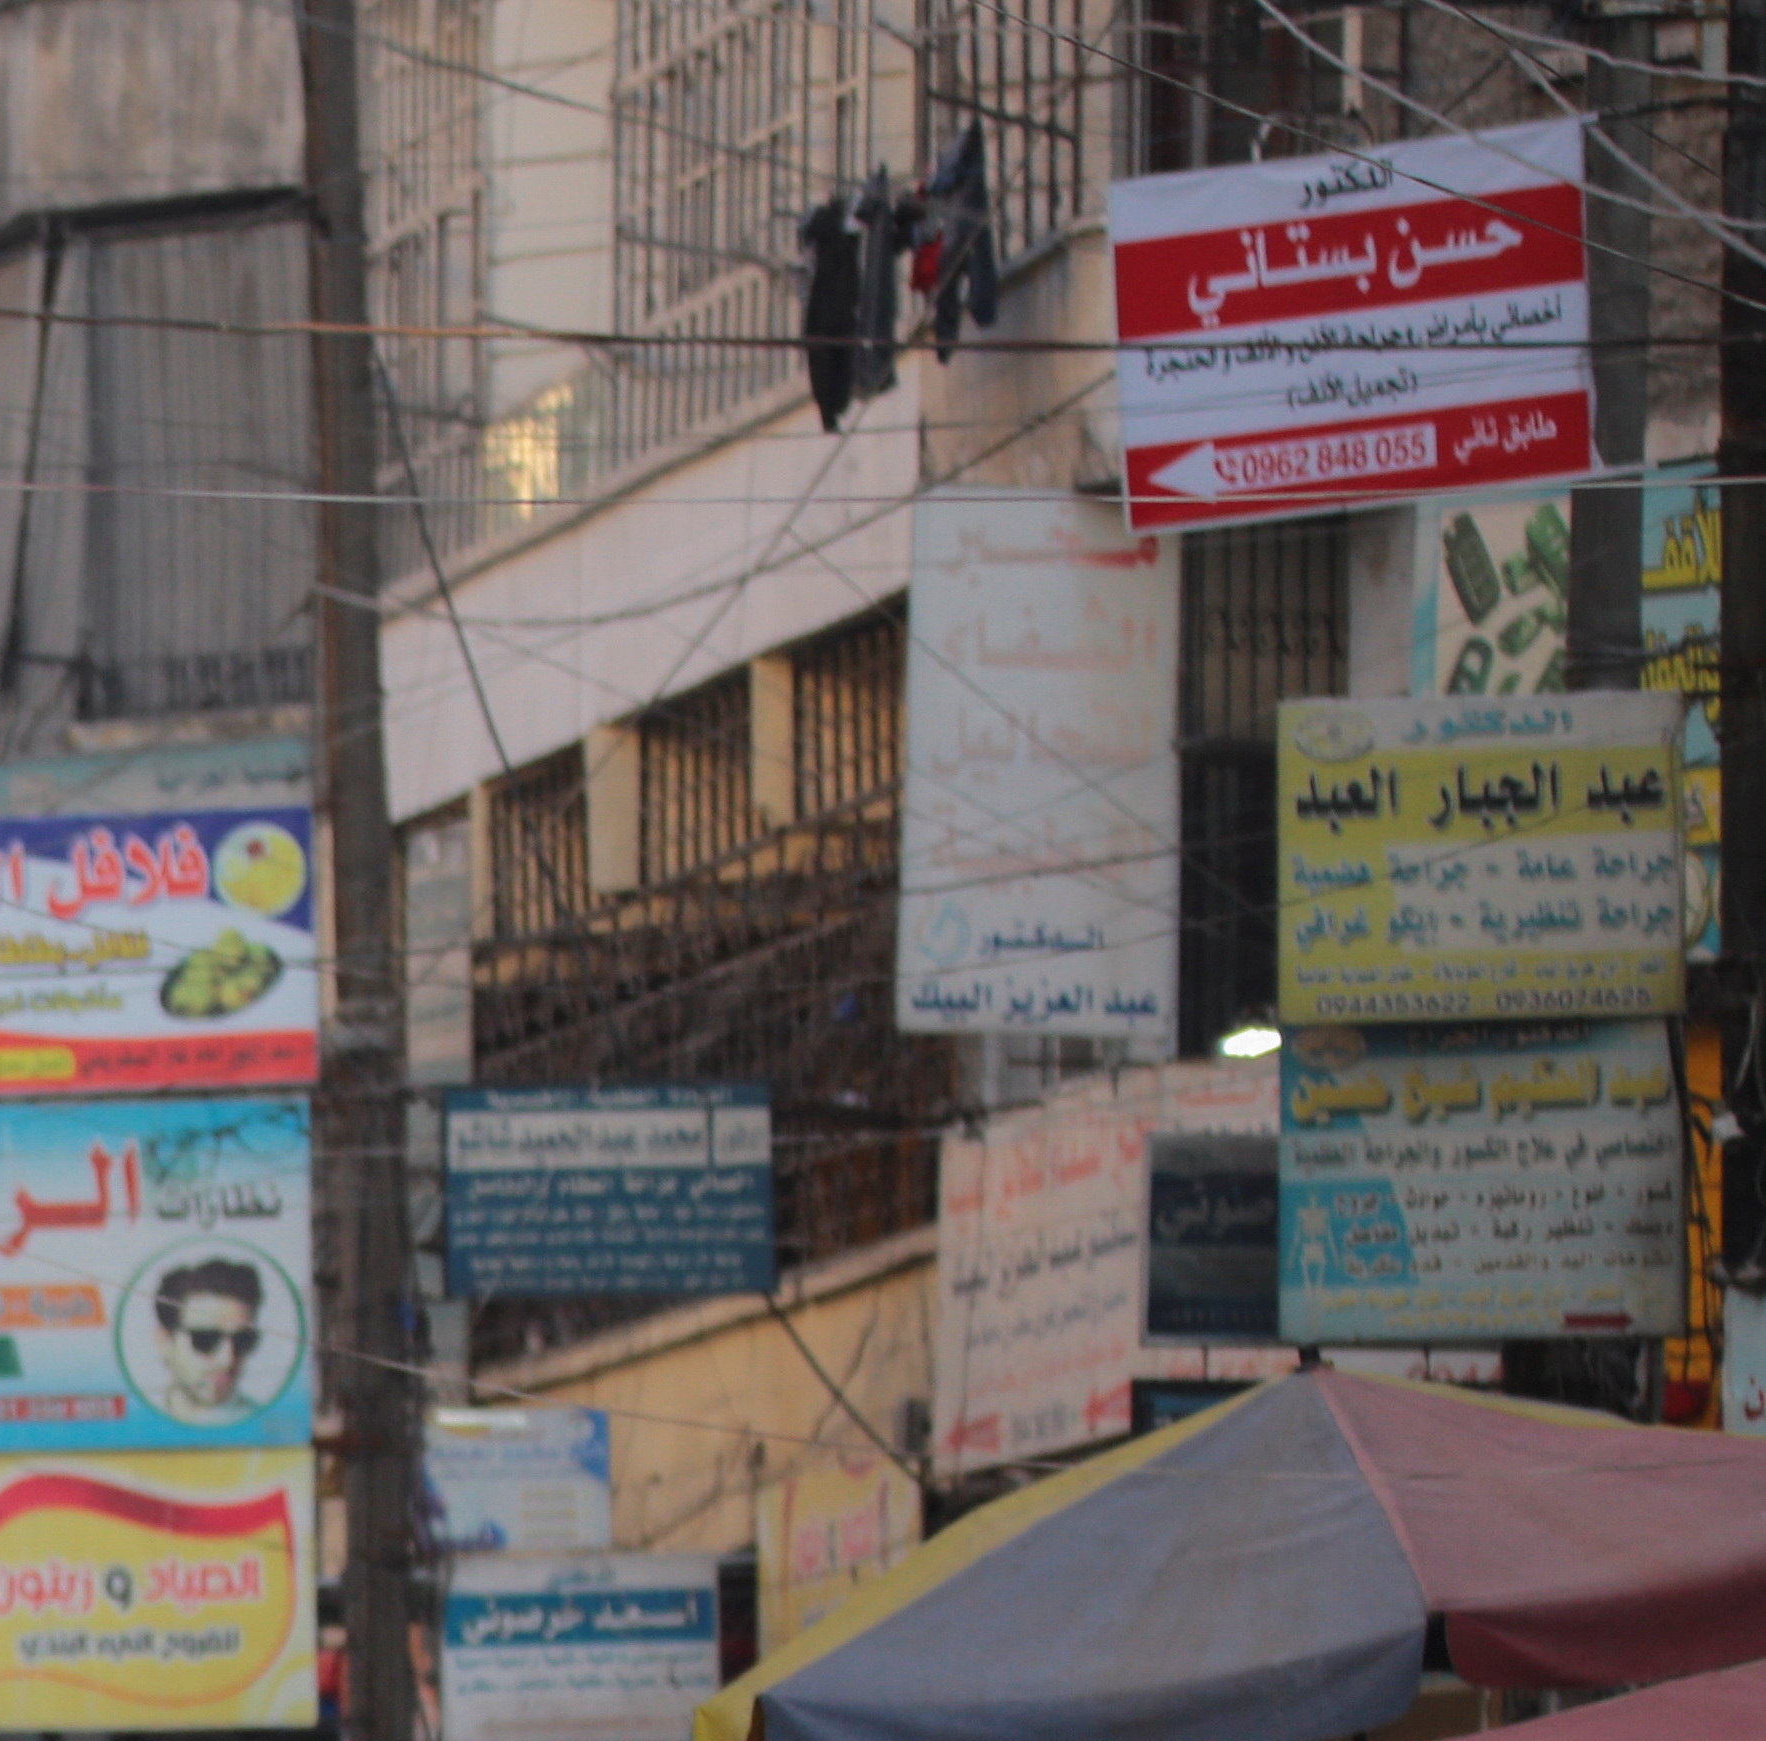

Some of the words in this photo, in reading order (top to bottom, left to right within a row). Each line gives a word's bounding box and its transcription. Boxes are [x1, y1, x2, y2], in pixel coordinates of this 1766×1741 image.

[1299, 159, 1395, 211] الدكتور
[1188, 219, 1376, 327] بستاني
[1388, 217, 1523, 288] حسن
[1242, 448, 1309, 486] 0962
[1317, 439, 1366, 474] 848
[1376, 433, 1427, 467] 055
[1401, 707, 1572, 743] الدكتور
[1427, 761, 1558, 831] الجبار
[1586, 762, 1663, 827] عبد
[49, 823, 210, 919] فلافل
[978, 919, 1104, 956] الدكتور
[1003, 975, 1094, 1024] العزيز
[1105, 988, 1157, 1029] عبد
[158, 1176, 285, 1232] نظارات
[105, 1565, 132, 1611] و
